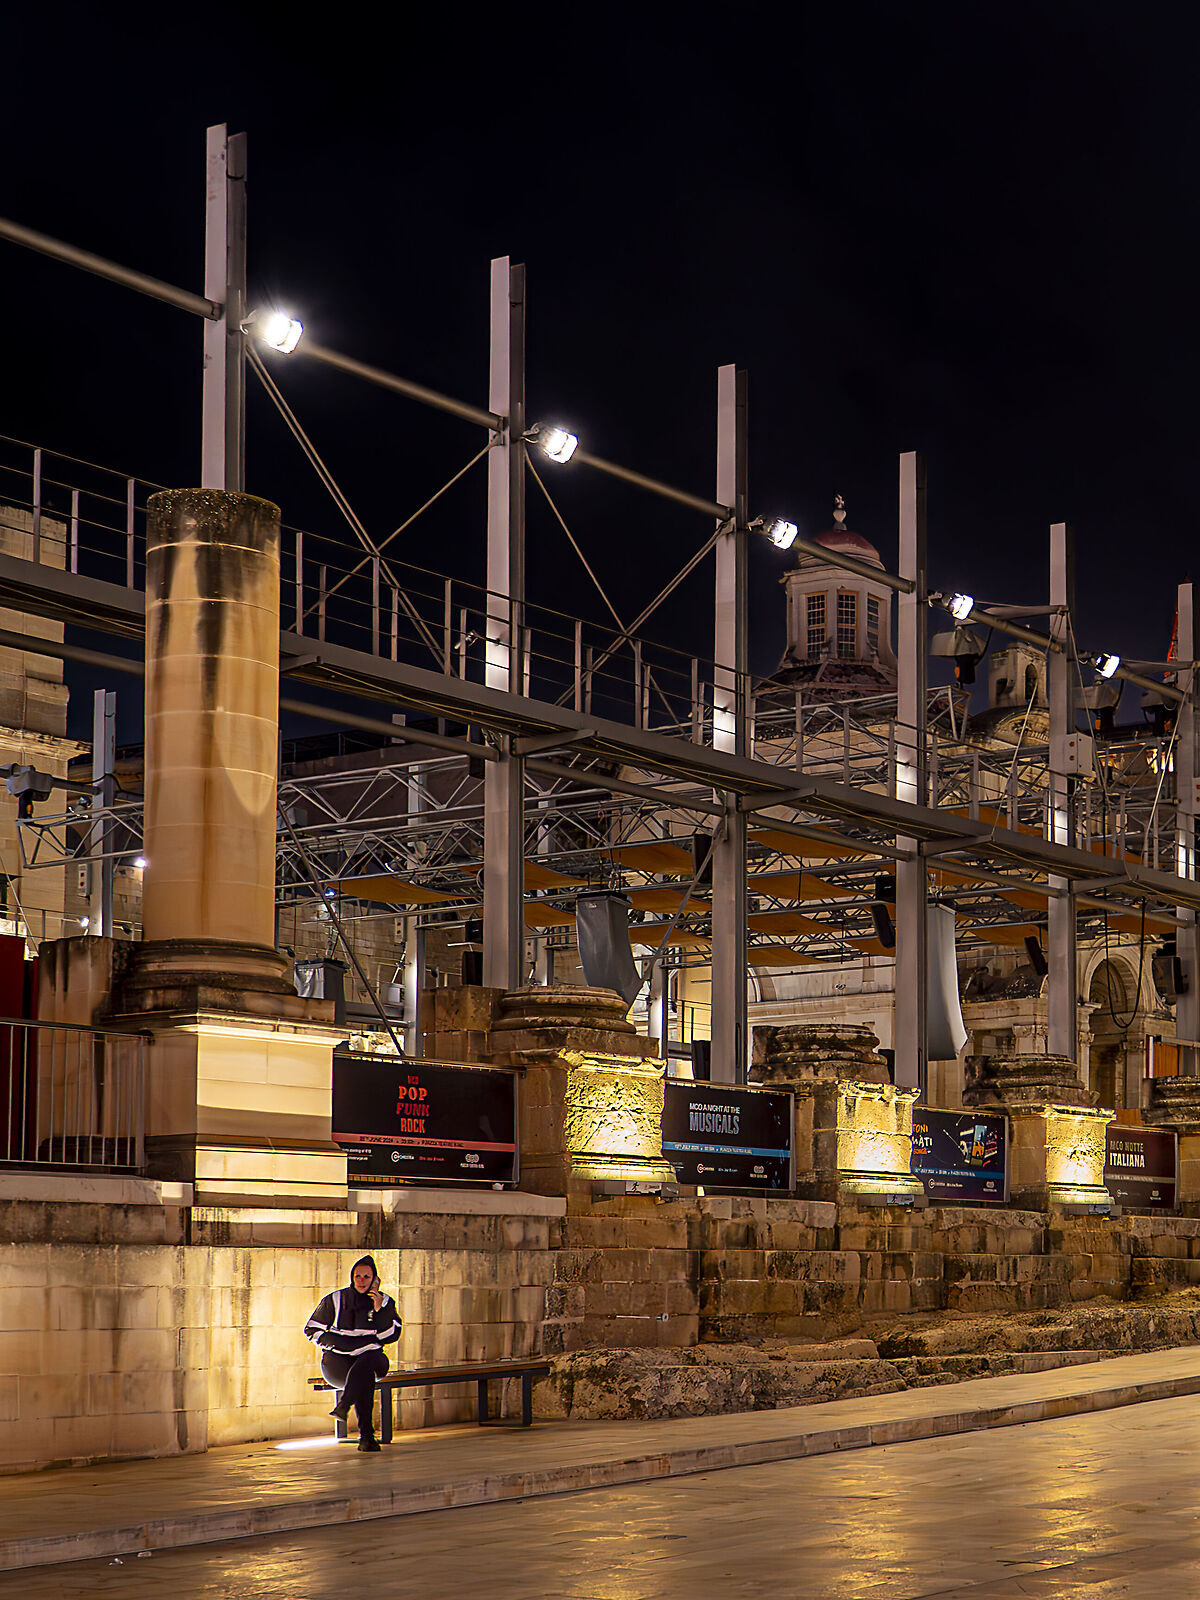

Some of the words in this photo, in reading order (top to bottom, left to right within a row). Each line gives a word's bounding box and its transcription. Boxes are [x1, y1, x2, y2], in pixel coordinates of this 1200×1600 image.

[399, 1086, 428, 1101] POP
[396, 1102, 430, 1117] FUNK
[689, 1103, 703, 1111] MCO
[708, 1104, 723, 1112] NIGHT
[723, 1105, 730, 1113] AT
[730, 1106, 740, 1114] THE
[400, 1117, 426, 1133] ROCK
[689, 1111, 740, 1135] MUSICALS
[1124, 1142, 1144, 1153] NOTTE
[1109, 1152, 1145, 1168] ITALIANA
